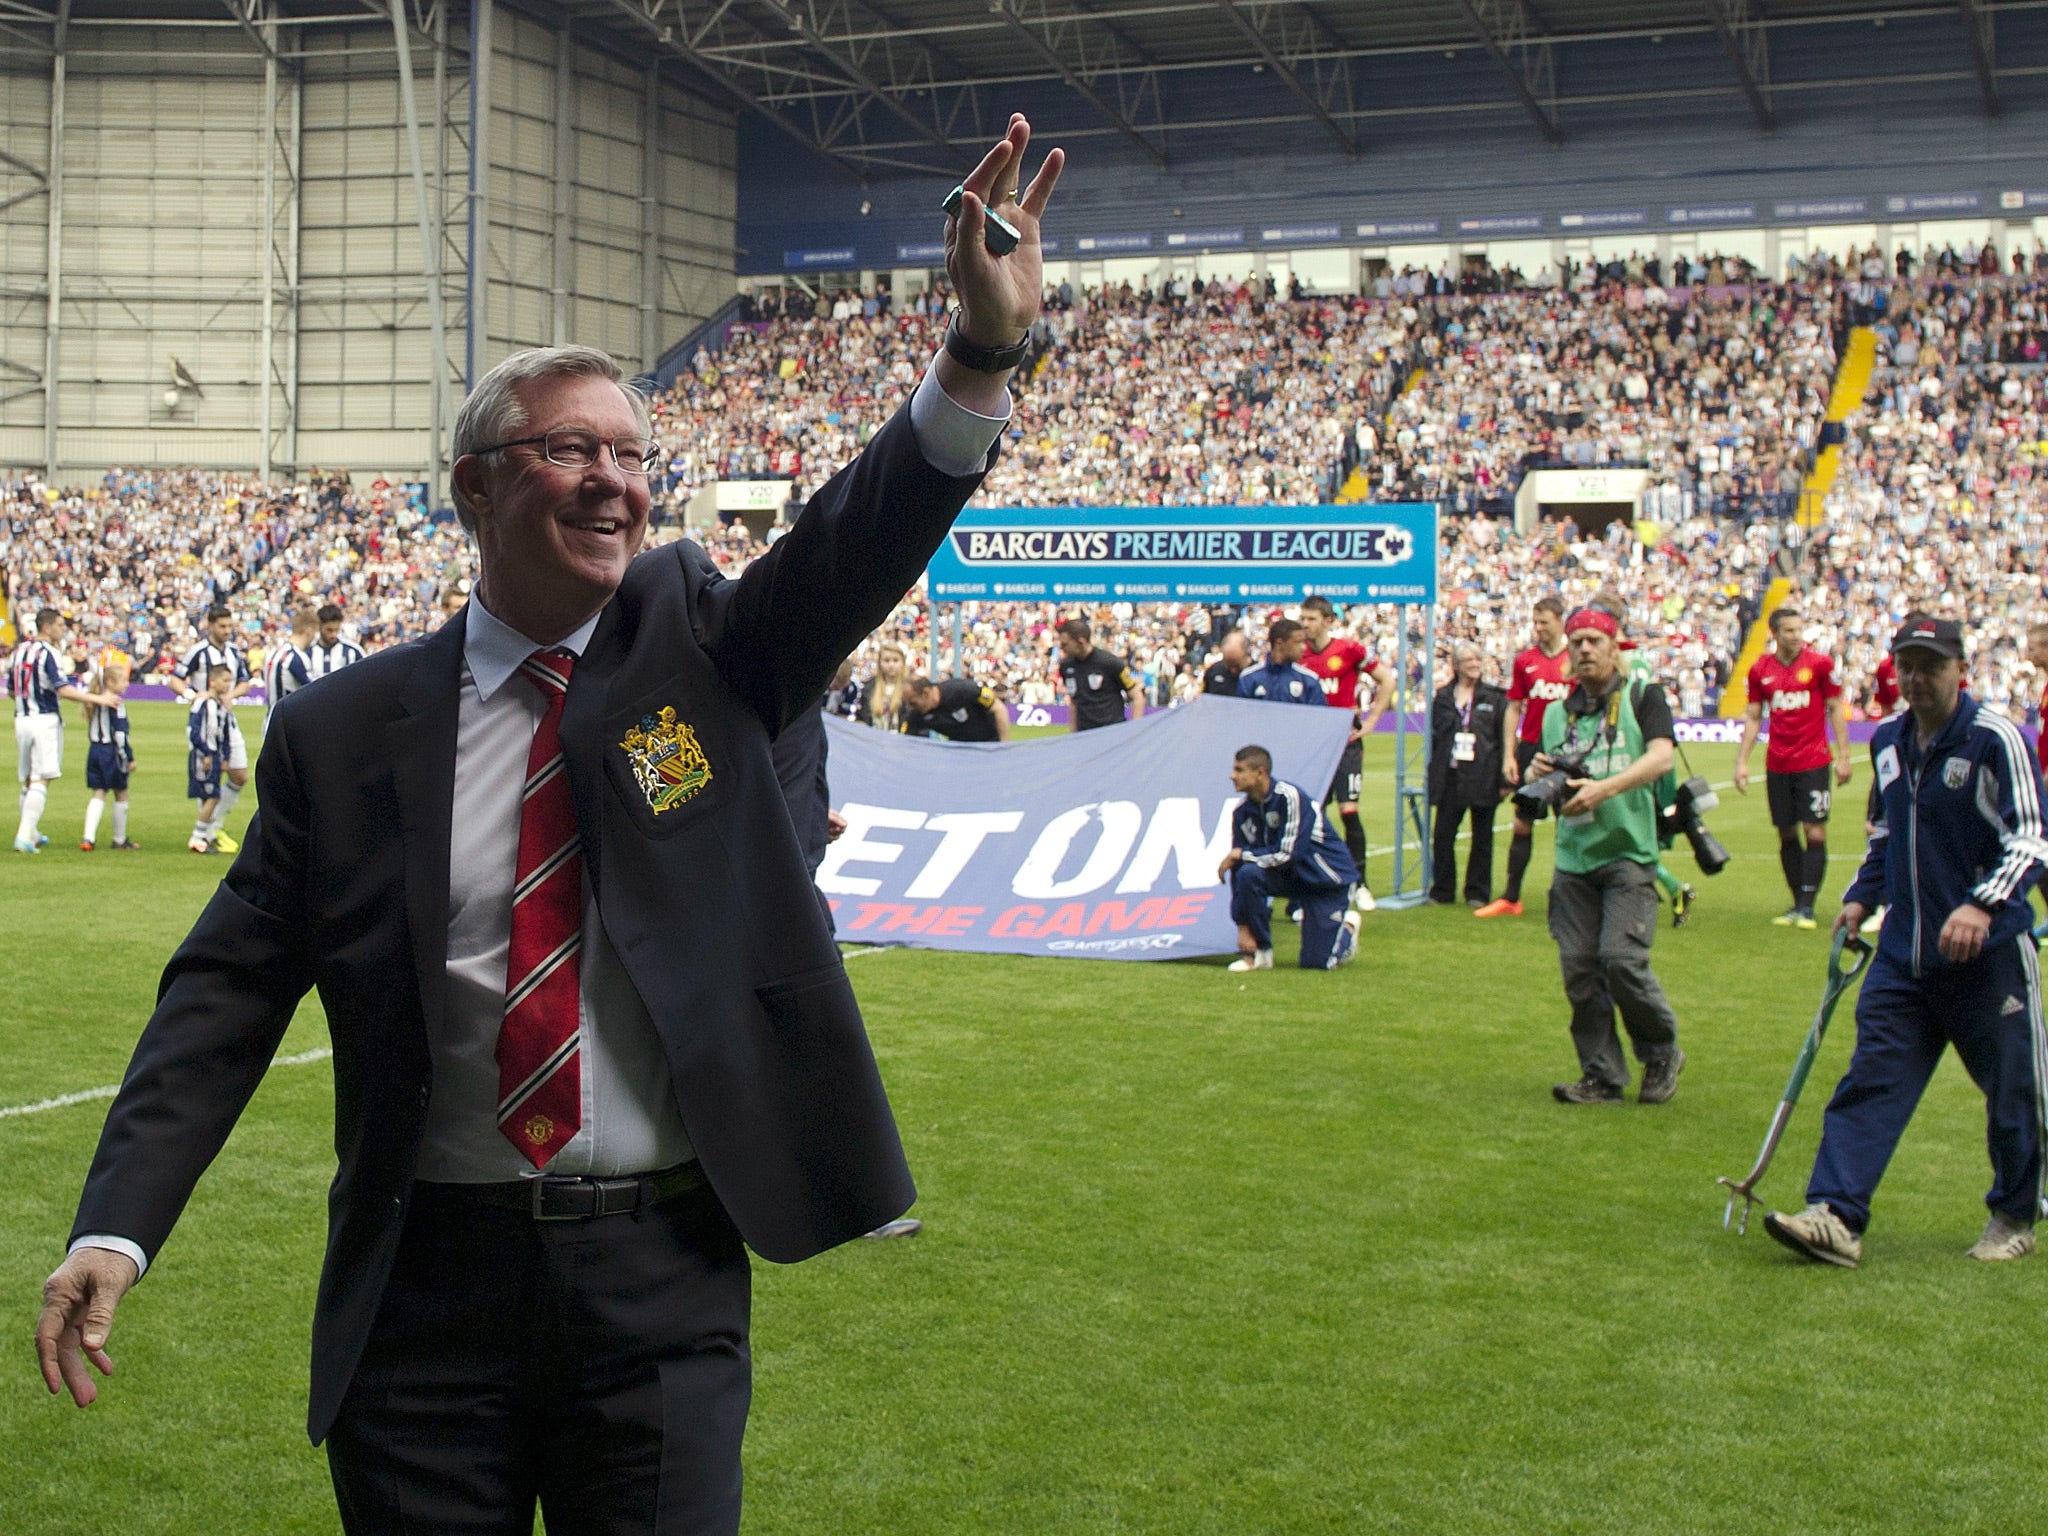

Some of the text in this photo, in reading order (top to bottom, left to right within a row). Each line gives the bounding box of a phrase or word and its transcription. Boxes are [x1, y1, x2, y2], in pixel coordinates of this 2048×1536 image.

[969, 530, 1369, 560] BARCLAYS PREMIER LEAGUE
[946, 583, 1426, 595] BARCLAYS BARCLAYS BARCLAYS BARCLAYS BARCLAYS BARCLAYS BARCLAYS BARCLAYS
[1809, 790, 1831, 812] 20
[816, 797, 1246, 898] ET ON
[847, 893, 1214, 939] THE GAME
